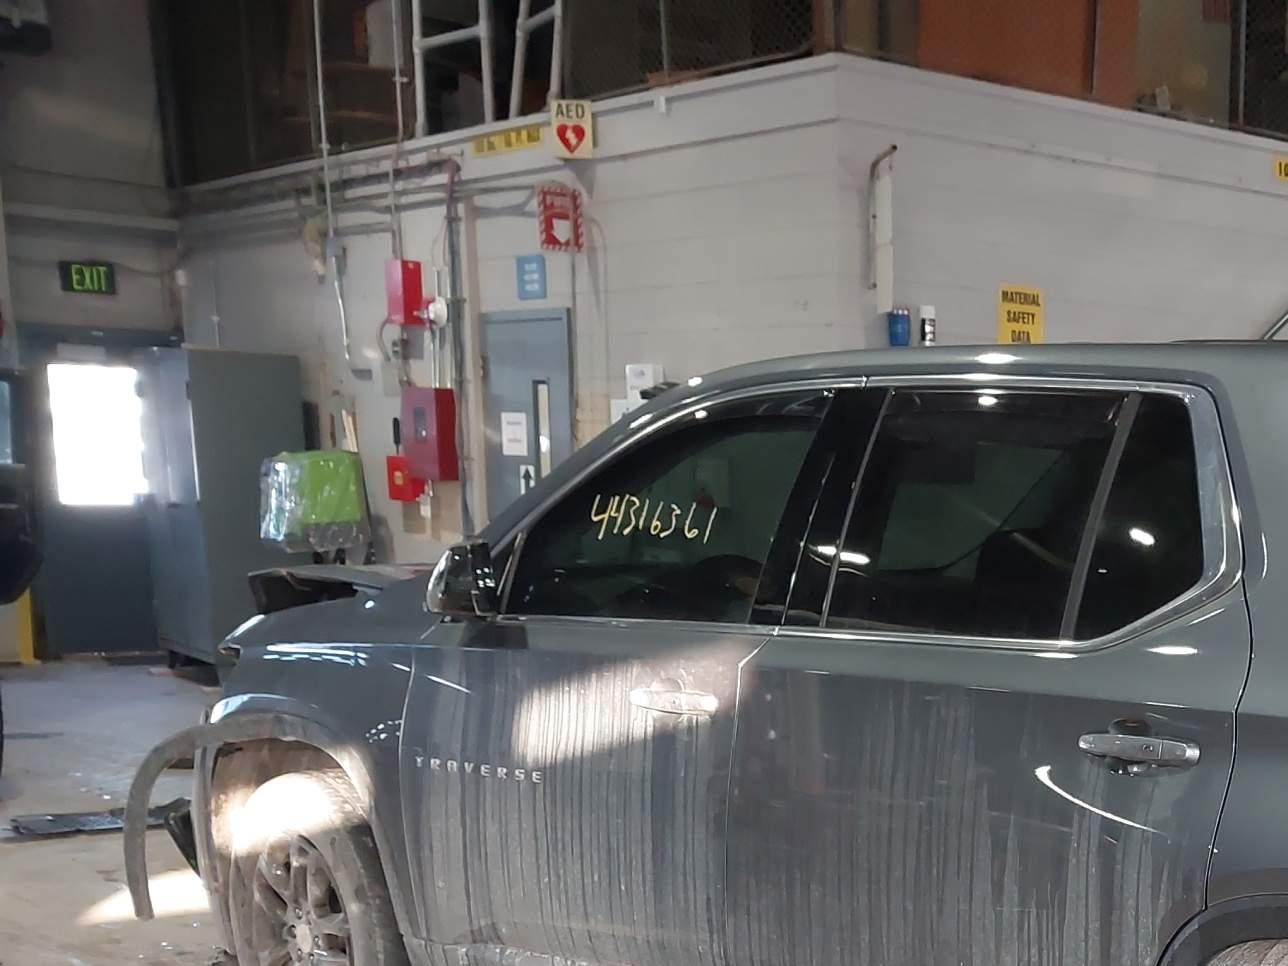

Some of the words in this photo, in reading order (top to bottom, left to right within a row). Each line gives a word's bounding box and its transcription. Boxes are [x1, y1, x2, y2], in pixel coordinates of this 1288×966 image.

[556, 103, 585, 119] AED
[71, 264, 107, 291] EXIT
[1001, 290, 1041, 307] MATERIAL
[1006, 310, 1036, 325] SAFETY
[1010, 329, 1032, 344] DATA
[591, 494, 718, 544] 44316361
[415, 756, 543, 784] TRAVERSE
